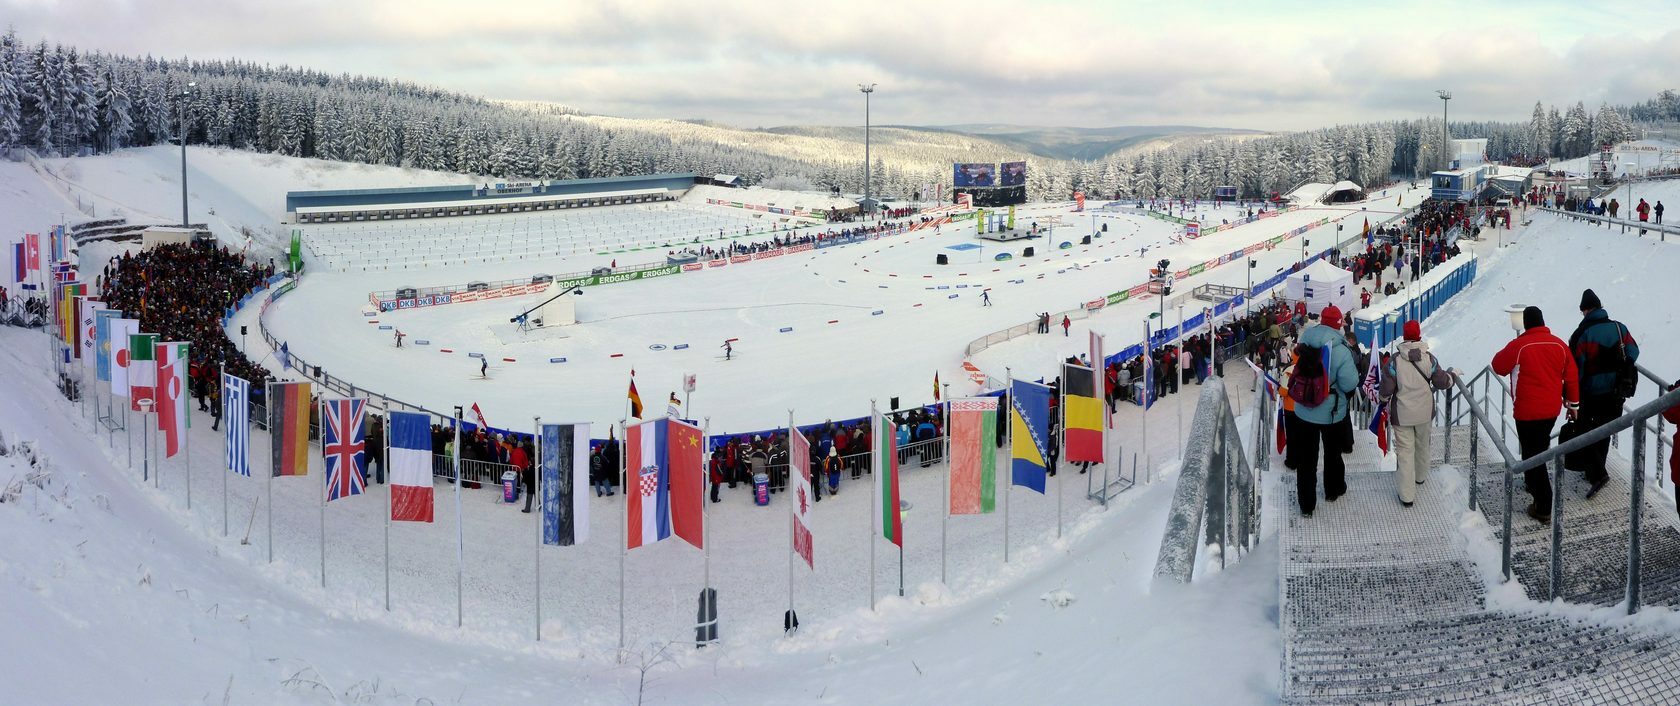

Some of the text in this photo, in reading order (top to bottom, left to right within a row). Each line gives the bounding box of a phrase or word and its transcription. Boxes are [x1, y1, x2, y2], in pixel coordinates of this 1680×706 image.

[559, 267, 671, 289] RDGAS ERDGAS ERDGAS
[381, 295, 451, 310] DKB DKB DKB DKB
